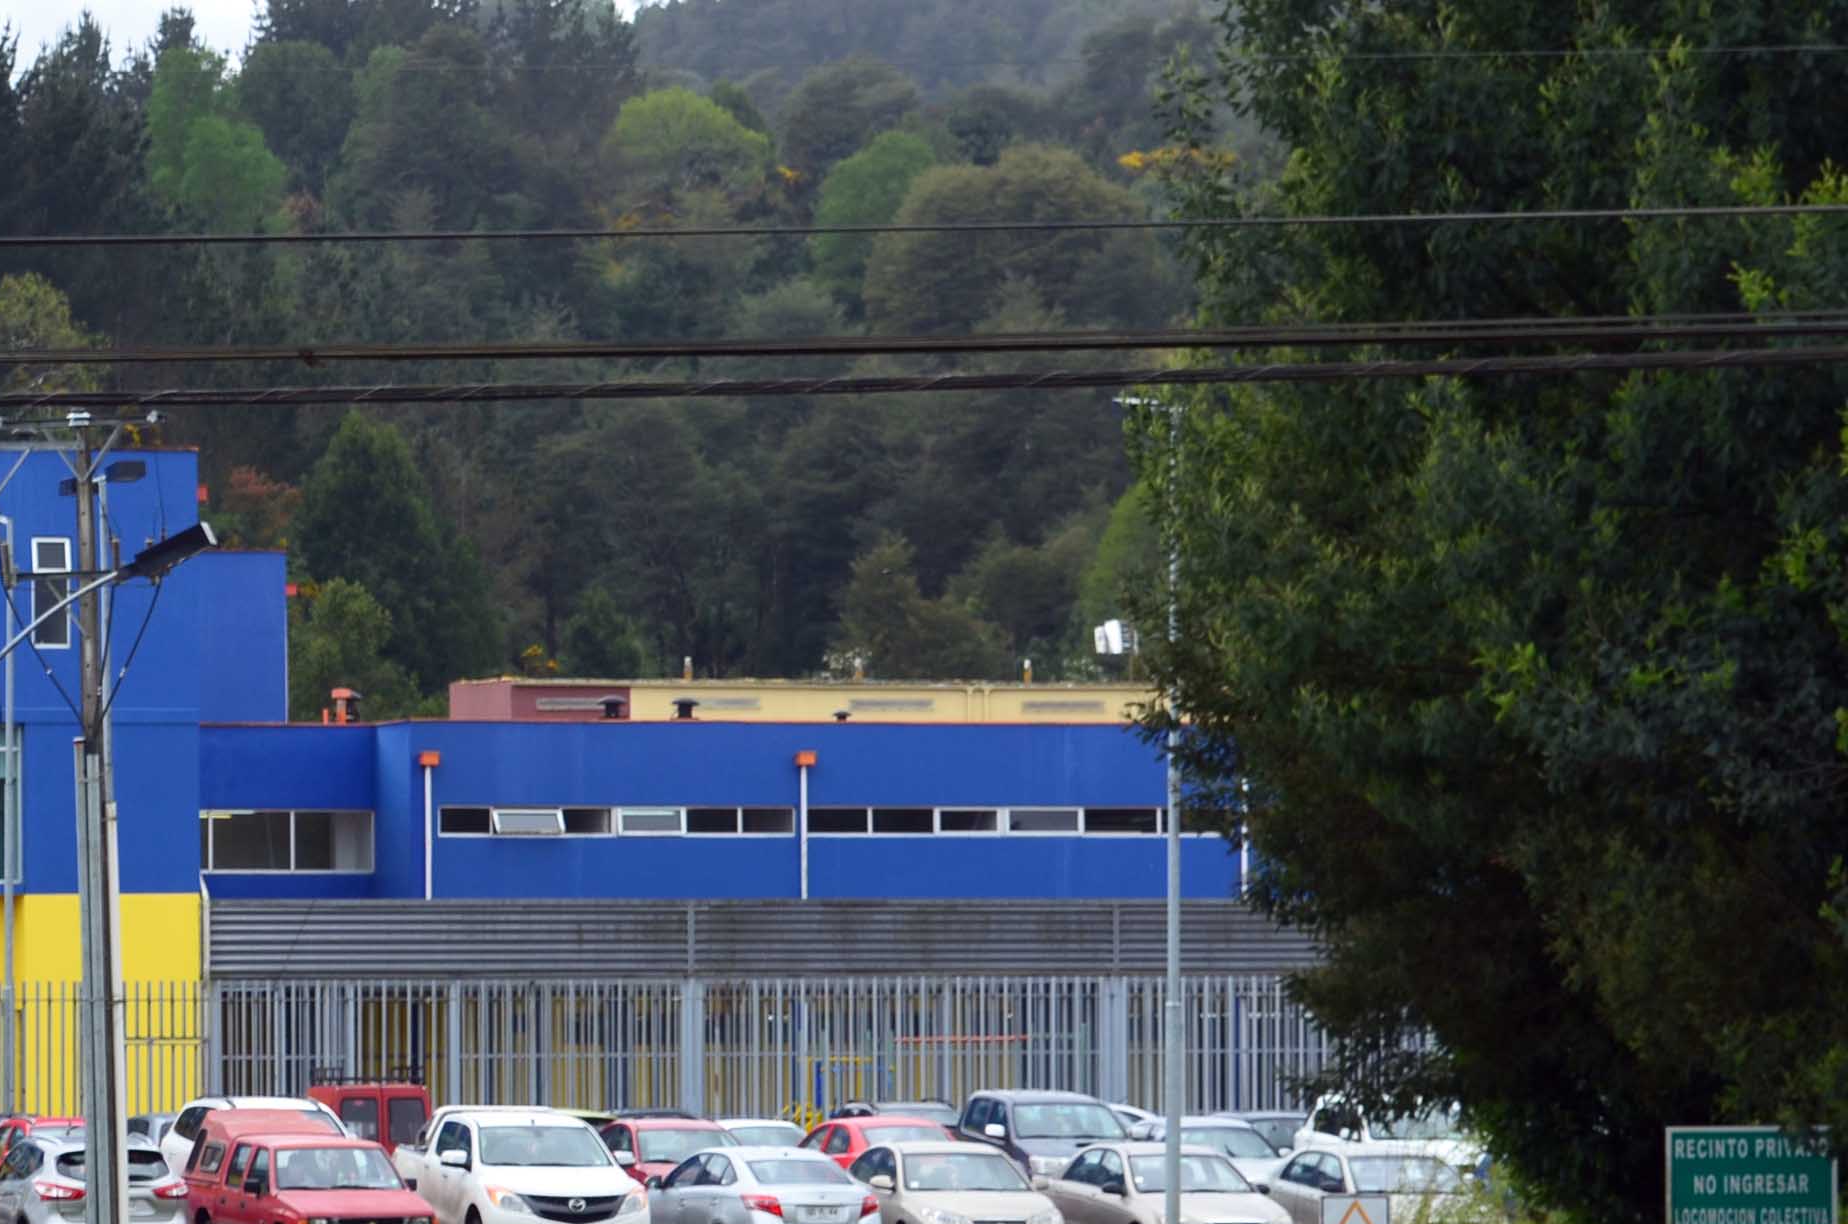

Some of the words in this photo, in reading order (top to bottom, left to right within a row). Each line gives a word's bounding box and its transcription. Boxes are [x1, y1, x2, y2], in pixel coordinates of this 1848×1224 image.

[1674, 1138, 1749, 1159] RECINTO
[1693, 1174, 1717, 1194] NO
[1723, 1174, 1809, 1194] INGRESAR
